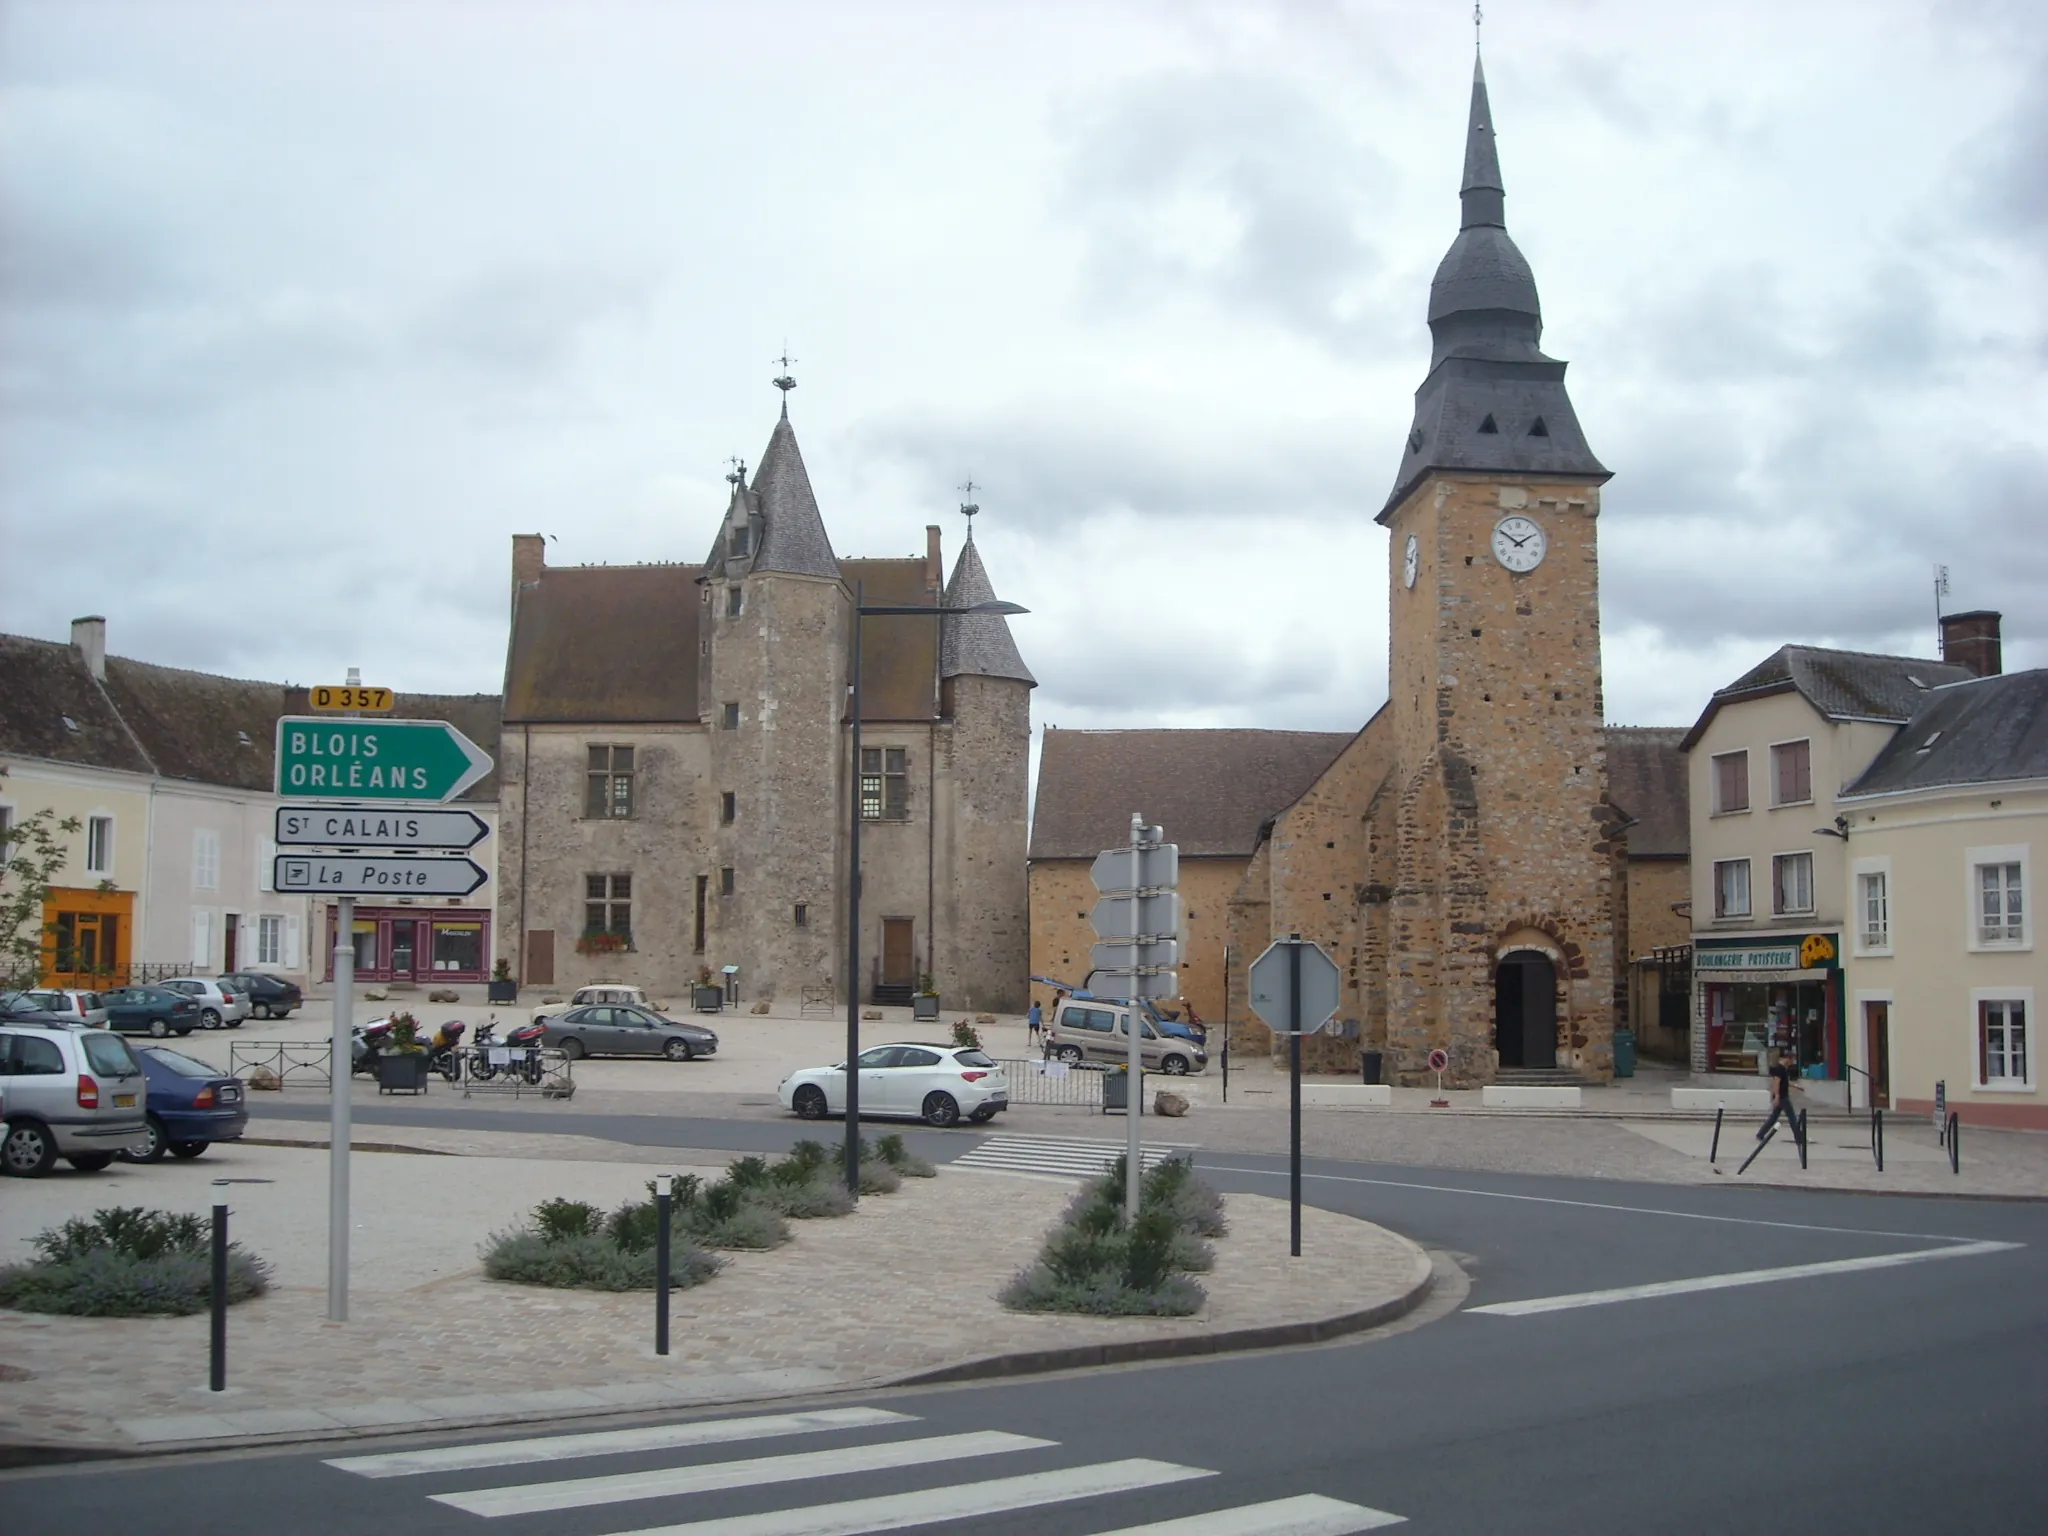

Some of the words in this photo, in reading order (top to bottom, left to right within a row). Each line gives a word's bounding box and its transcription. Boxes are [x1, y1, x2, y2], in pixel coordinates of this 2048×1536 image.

[318, 689, 331, 706] D
[341, 690, 386, 707] 357
[291, 732, 378, 757] BLOIS
[290, 760, 428, 790] ORLÉANS
[325, 818, 419, 837] CALAIS
[318, 866, 343, 884] La
[361, 866, 427, 885] Poste
[1696, 953, 1743, 966] BOULANGERIE
[1747, 951, 1792, 965] PATISSERIE
